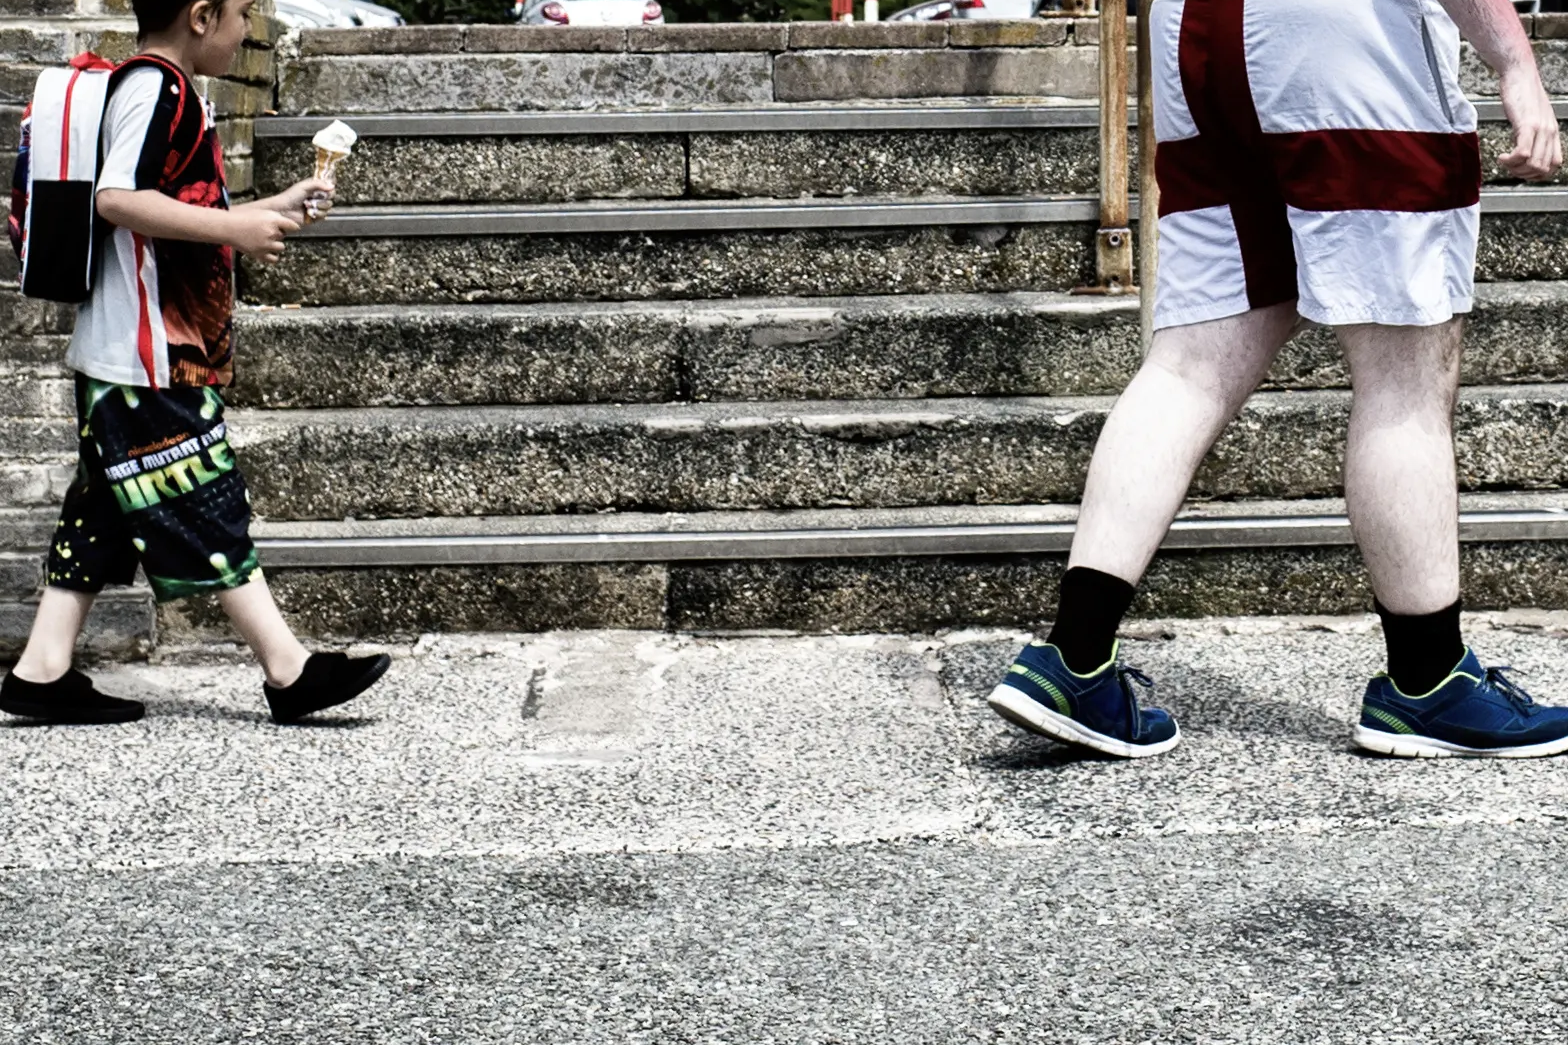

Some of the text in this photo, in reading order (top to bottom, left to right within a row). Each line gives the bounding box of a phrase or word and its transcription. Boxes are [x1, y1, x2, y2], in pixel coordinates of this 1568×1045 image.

[127, 432, 190, 457] nickelodeon
[141, 437, 201, 470] MUTANT
[111, 438, 235, 514] URTLE
